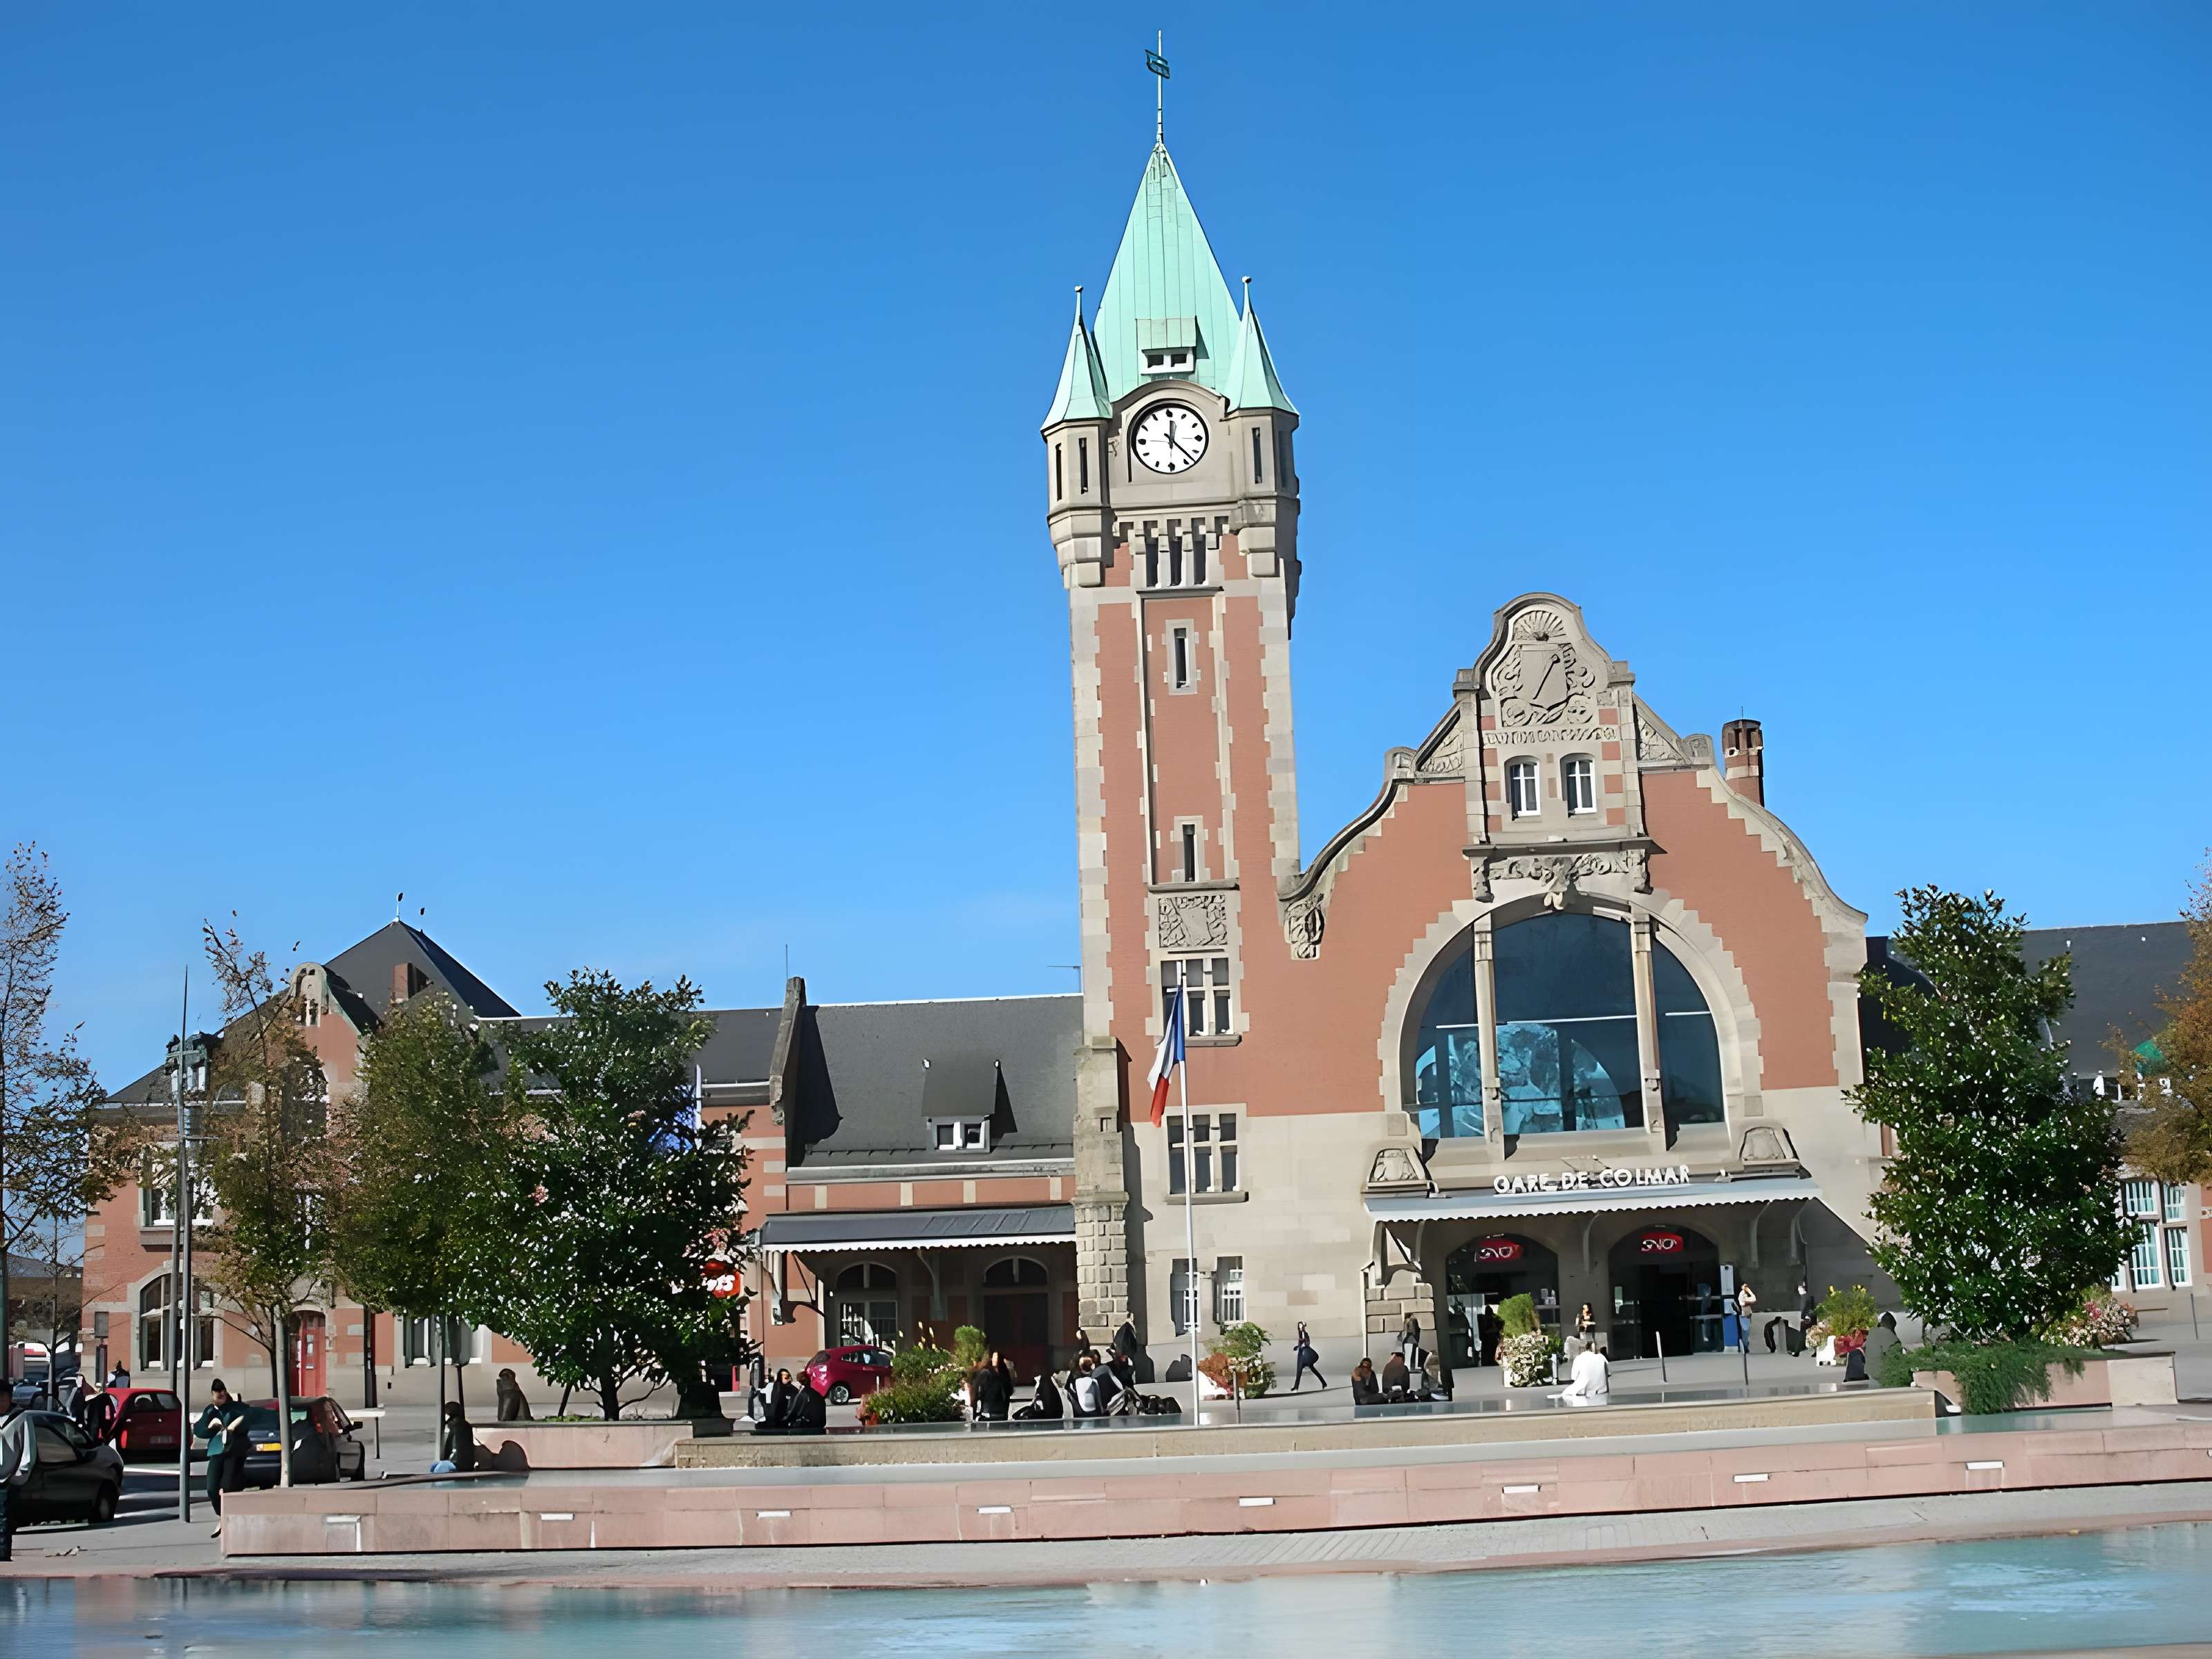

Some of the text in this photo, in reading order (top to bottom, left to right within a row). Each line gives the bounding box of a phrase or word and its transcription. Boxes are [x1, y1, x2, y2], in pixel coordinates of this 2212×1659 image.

[1493, 1164, 1691, 1194] GARE DE COLMAR
